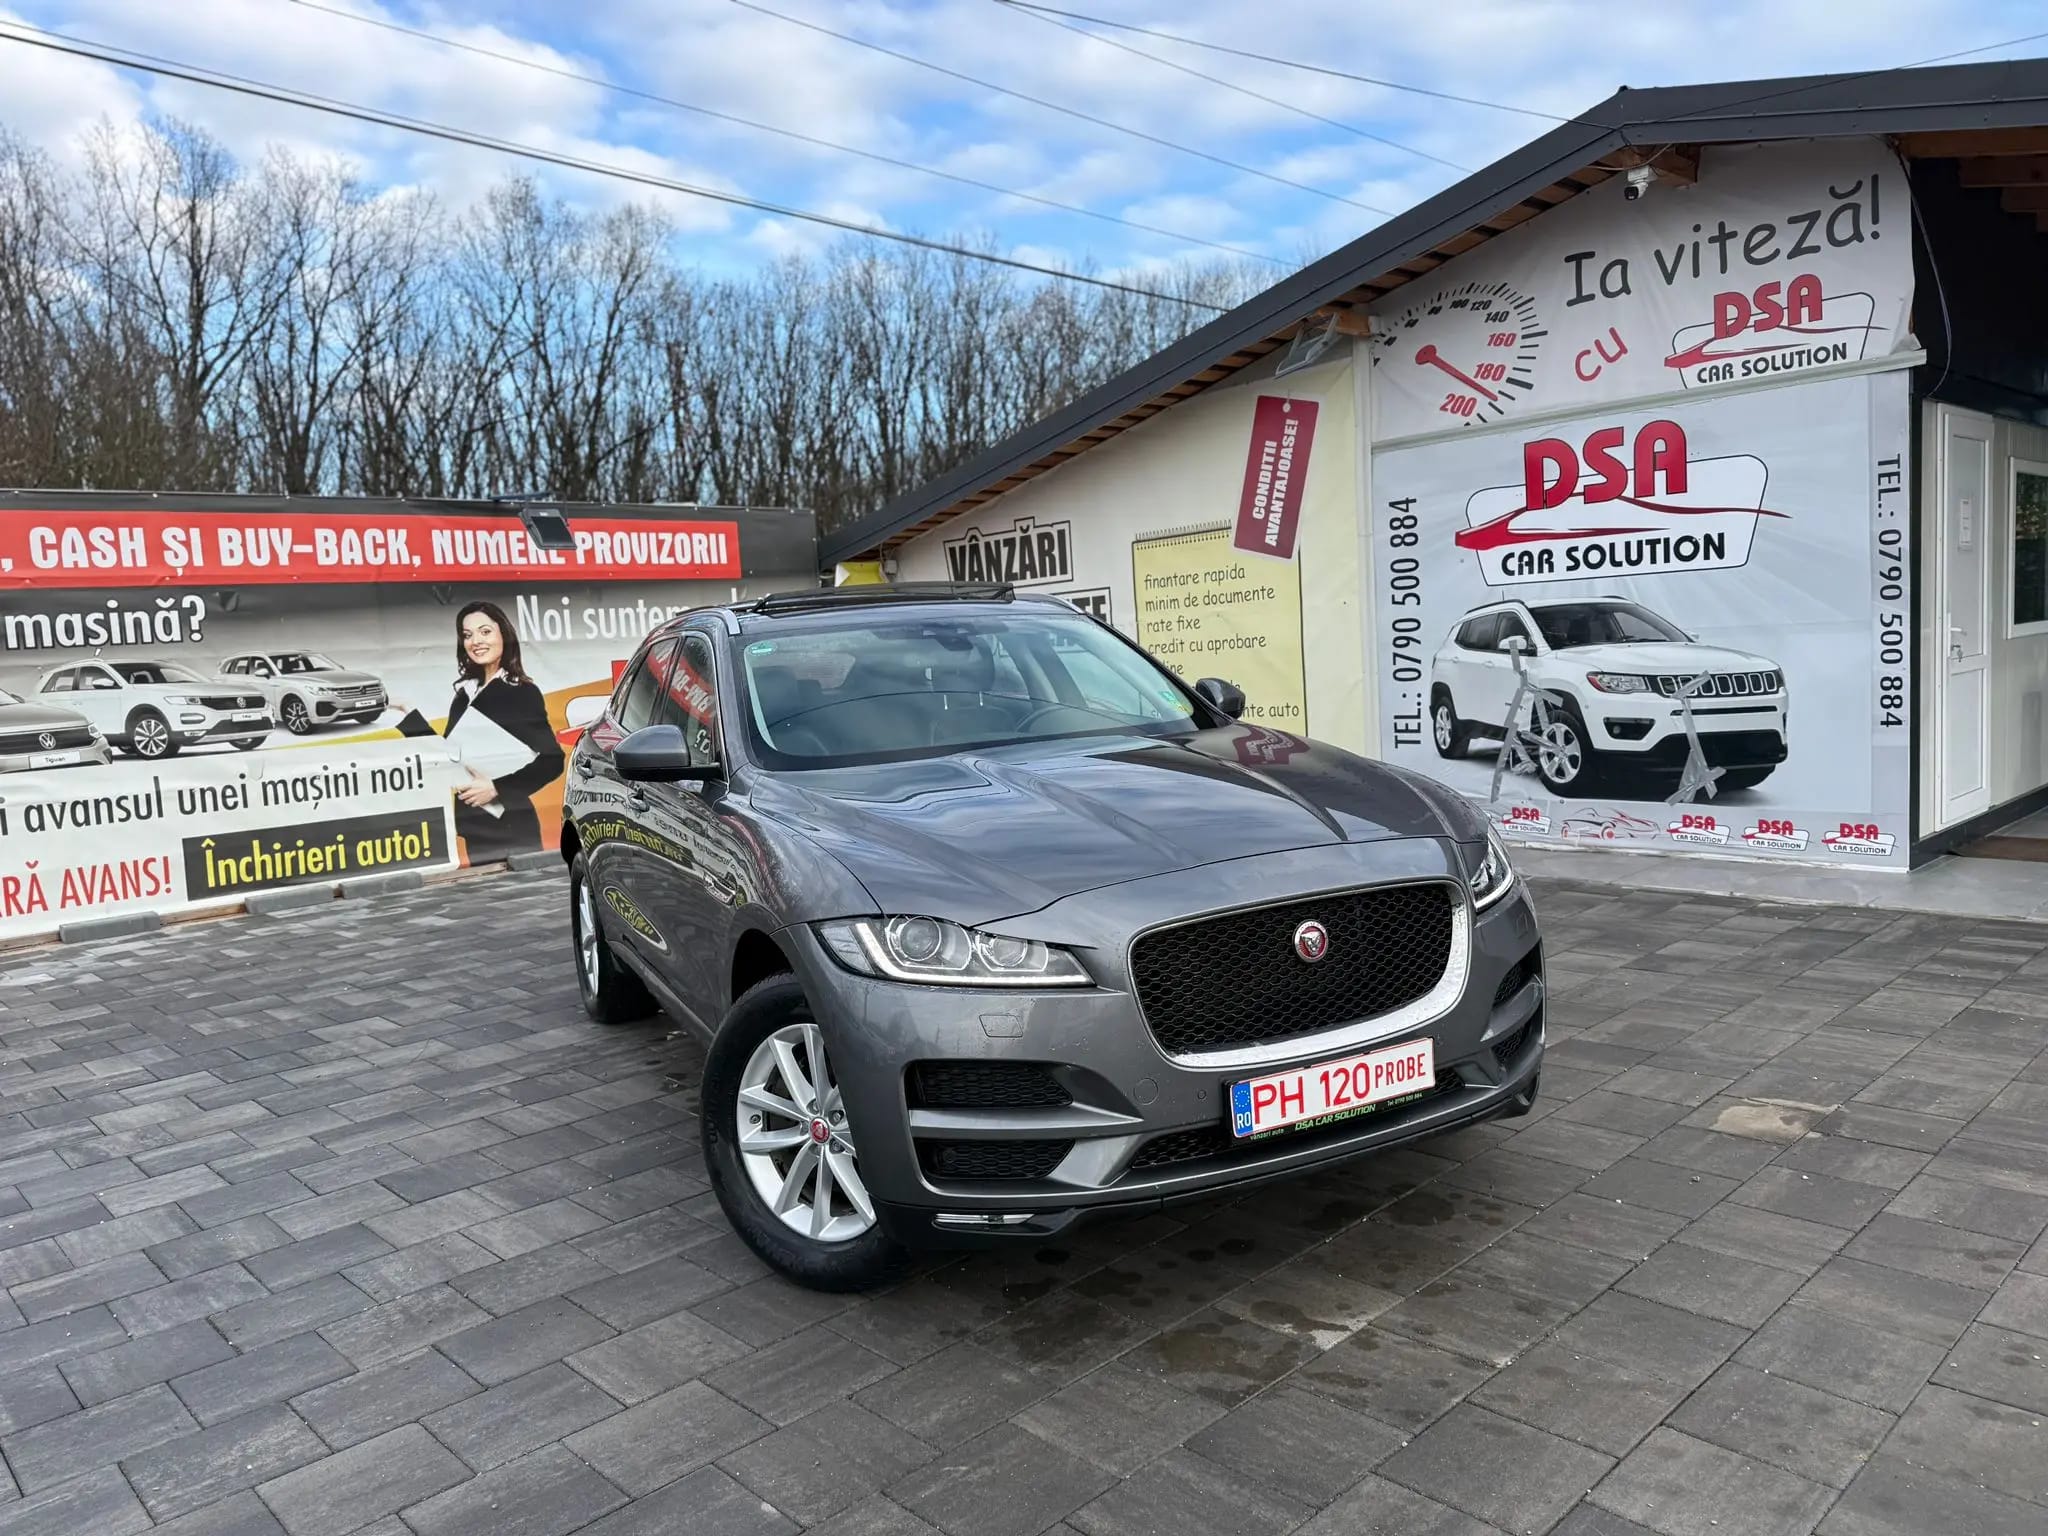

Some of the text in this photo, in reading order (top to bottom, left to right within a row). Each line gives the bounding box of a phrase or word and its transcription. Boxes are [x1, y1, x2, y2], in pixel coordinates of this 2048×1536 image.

[1564, 174, 1880, 307] Ia viteză!
[1470, 300, 1492, 311] 120
[1485, 311, 1509, 323] 140
[1714, 274, 1823, 339] DSA
[1487, 333, 1516, 347] 160
[1575, 327, 1628, 381] cu
[1474, 363, 1506, 381] 180
[1697, 342, 1848, 384] CAR SOLUTION
[1440, 394, 1477, 417] 200
[1523, 418, 1688, 511] DSA
[1252, 440, 1277, 519] CONDITII
[1265, 418, 1299, 546] AVANTAJOASE!
[29, 526, 148, 569] CASH
[162, 526, 205, 576] ȘI
[217, 527, 421, 568] BUY-BACK,
[573, 530, 729, 566] PROVIZORII
[948, 525, 1069, 582] VÂNZĂRI
[1500, 531, 1726, 577] CAR SOLUTION
[1144, 563, 1246, 590] finantare rapida
[1877, 453, 1904, 728] TEL.: 0790 500 884
[1145, 585, 1276, 612] minim de documente
[5, 594, 206, 656] mașină?
[516, 594, 573, 642] Noi
[1147, 614, 1201, 633] rate fixe
[1389, 497, 1421, 748] TEL.: 0790 500 884
[1148, 633, 1267, 655] credit cu aprobare
[1268, 702, 1300, 718] auto
[24, 776, 164, 832] avansul
[178, 773, 249, 815] unei
[262, 763, 360, 811] mașini
[371, 754, 426, 793] noi!
[1511, 806, 1540, 821] DSA
[1681, 814, 1715, 831] DSA
[1758, 818, 1793, 836] DSA
[1690, 834, 1723, 844] SOLUTION
[1767, 841, 1802, 849] SOLUTION
[1839, 823, 1879, 840] DSA
[201, 821, 432, 889] Închirieri auto!
[1849, 845, 1887, 854] SOLUTION
[0, 856, 172, 918] RĂ AVANS!
[1253, 1052, 1427, 1124] PH 120 PROBE
[1236, 1111, 1251, 1130] RO
[1294, 1103, 1377, 1131] DSA CAR SOLUTION
